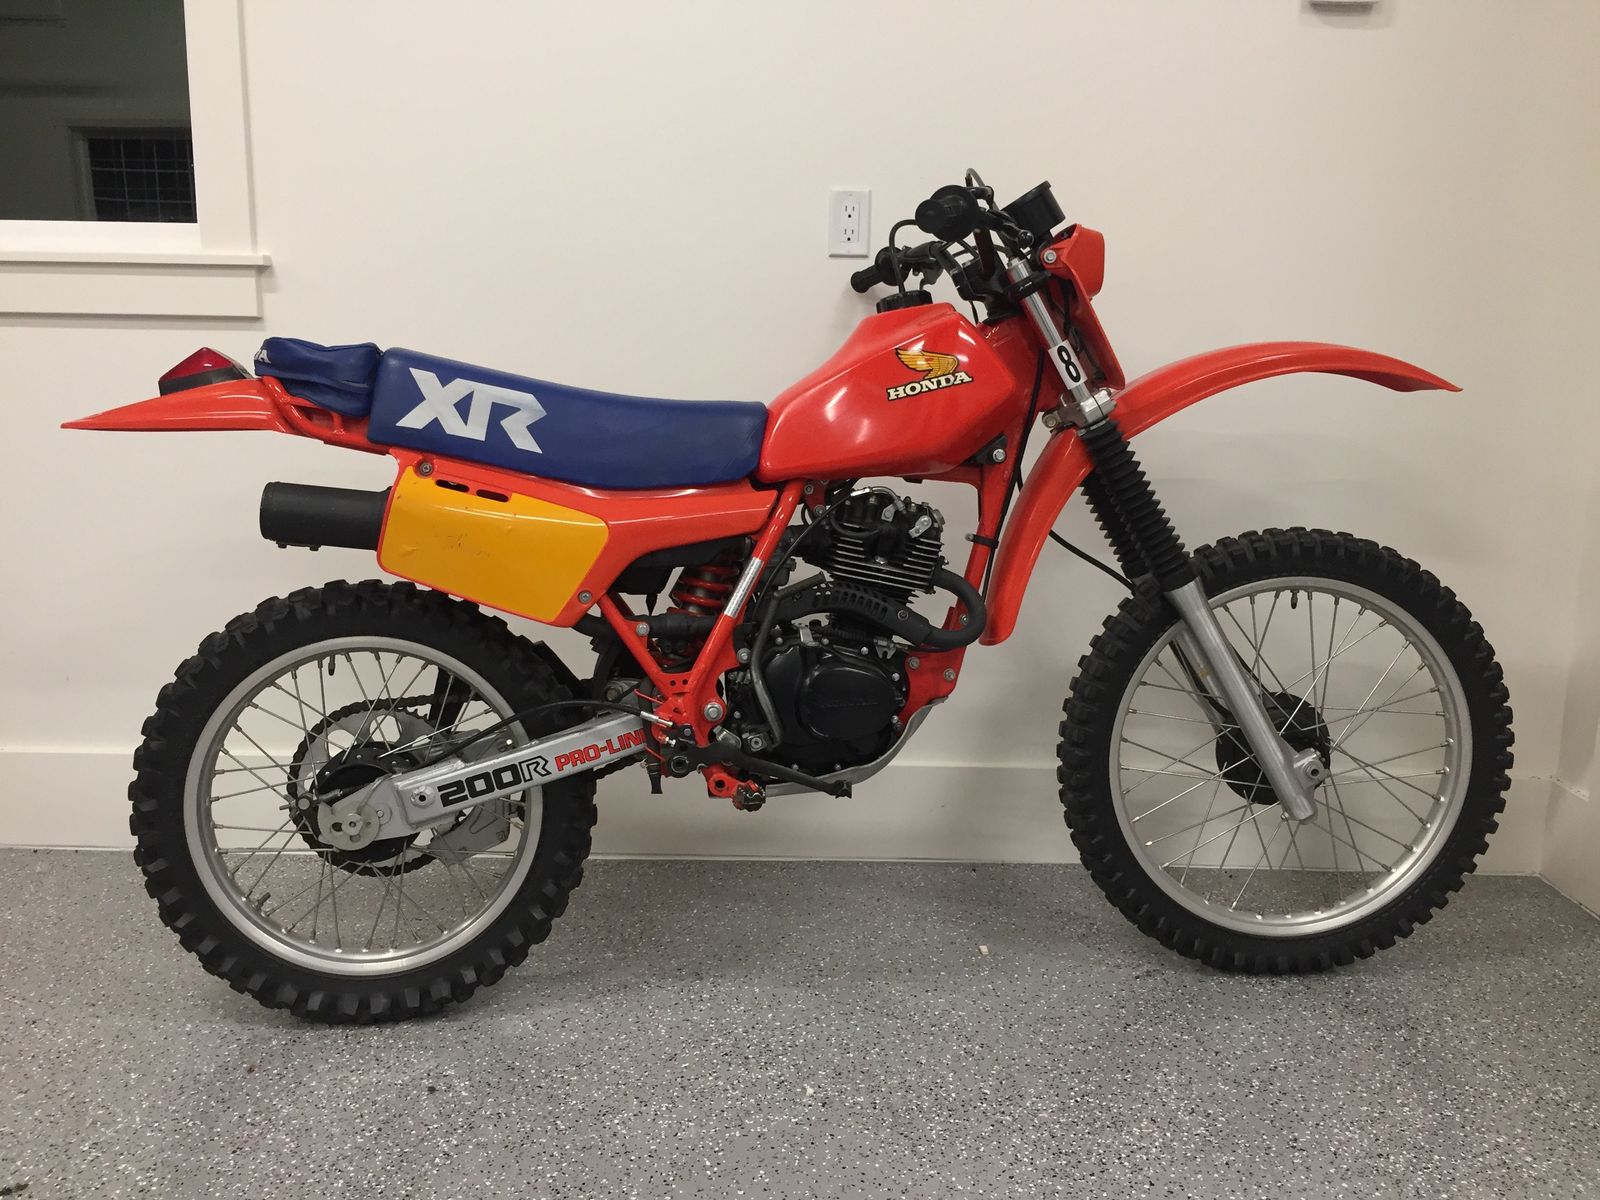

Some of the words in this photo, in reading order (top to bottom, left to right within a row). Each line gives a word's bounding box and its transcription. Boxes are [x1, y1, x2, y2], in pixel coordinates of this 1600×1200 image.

[887, 371, 973, 401] HONDA
[1057, 345, 1081, 383] 8
[395, 367, 547, 454] XR
[437, 755, 552, 808] 200R
